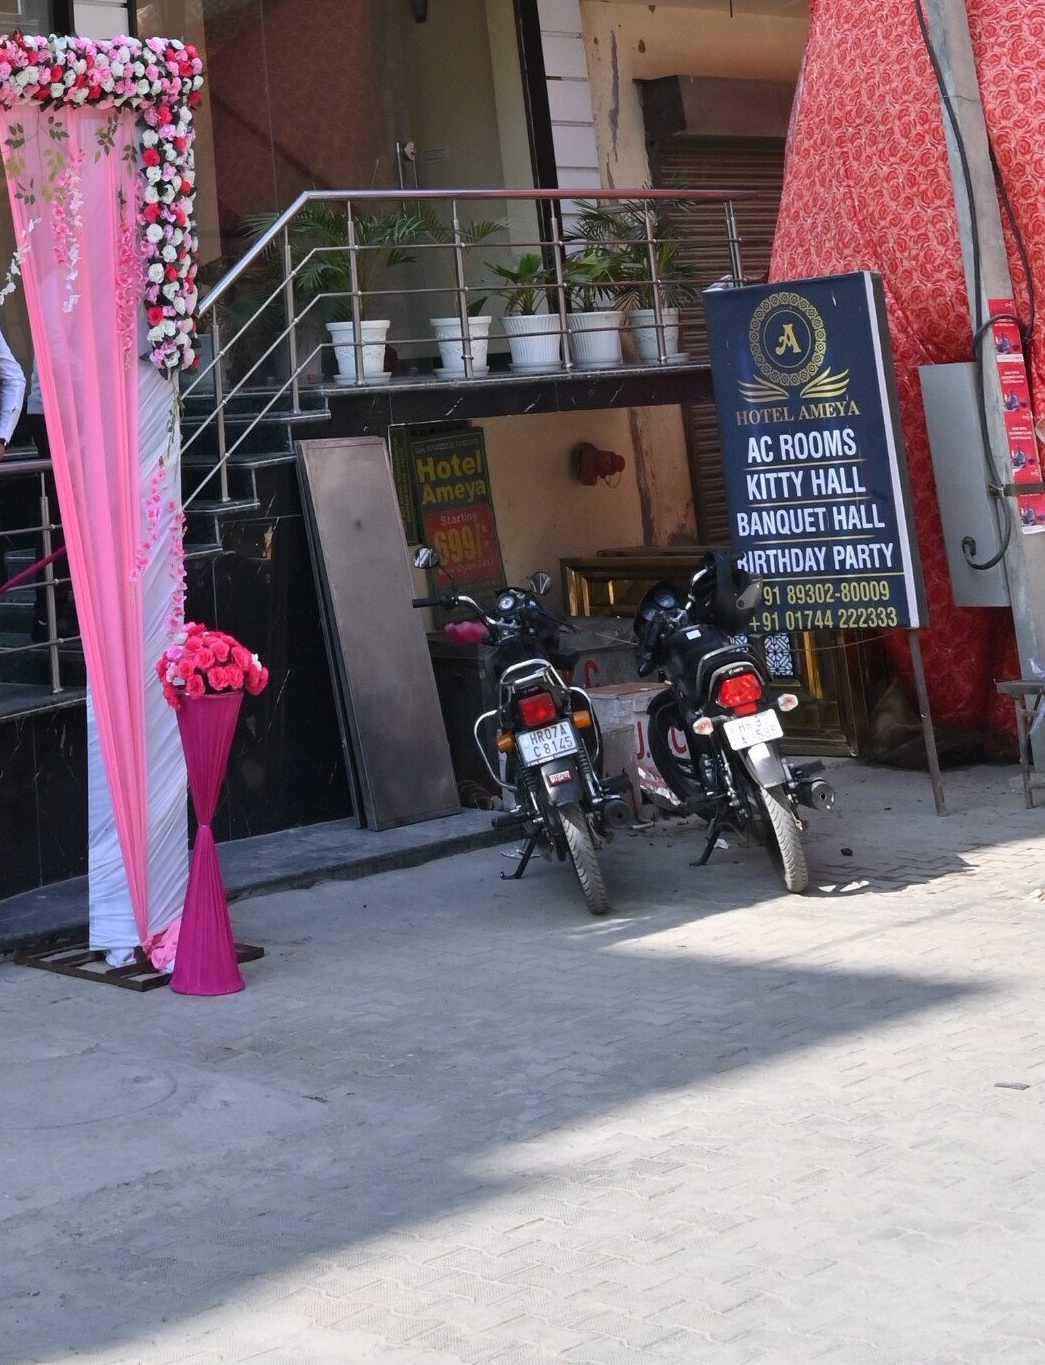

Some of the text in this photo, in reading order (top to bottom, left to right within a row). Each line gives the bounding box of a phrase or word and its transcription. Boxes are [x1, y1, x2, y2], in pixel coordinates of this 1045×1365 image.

[736, 400, 861, 426] HOTEL AMEYA
[747, 428, 857, 464] AC ROOMS
[416, 449, 482, 483] Hotel
[422, 479, 486, 505] Ameya
[746, 466, 866, 501] KITTY HALL
[440, 512, 478, 526] Starting
[737, 503, 885, 536] BANQUET HALL
[833, 543, 894, 570] PARTY
[787, 580, 890, 605] 89302-80009
[749, 606, 897, 632] +91 01744 222333
